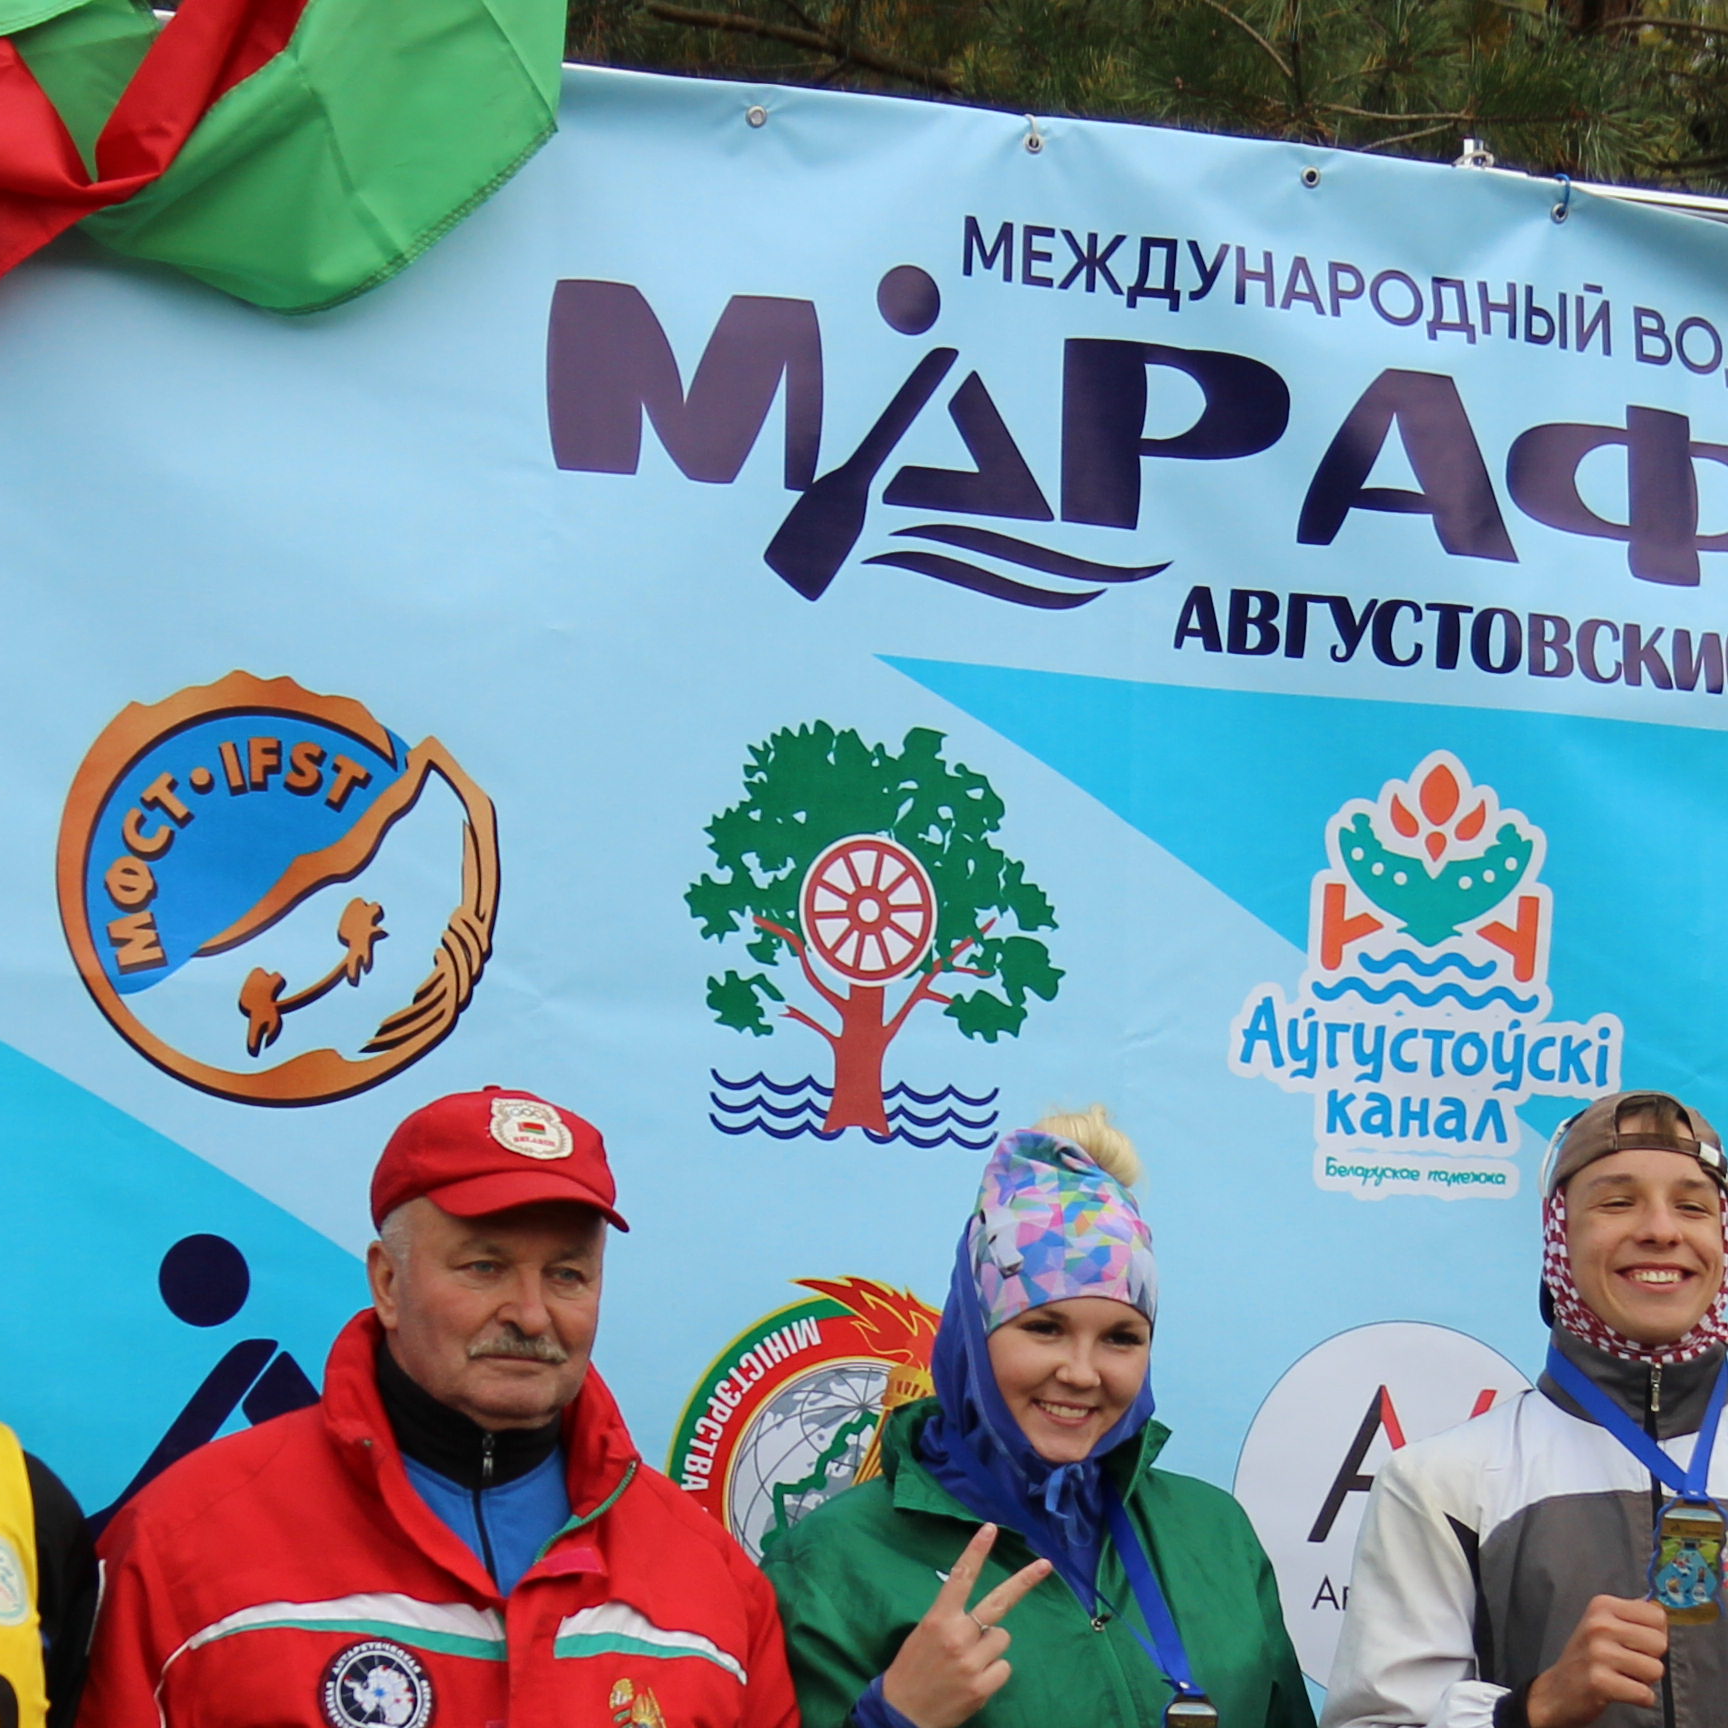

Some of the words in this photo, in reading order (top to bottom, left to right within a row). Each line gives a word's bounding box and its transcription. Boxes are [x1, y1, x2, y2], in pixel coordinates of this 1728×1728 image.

[960, 214, 1614, 357] МЕЖДУНАРОДНЫЙ
[219, 737, 372, 812] IFST
[1325, 1089, 1507, 1144] канал
[680, 1316, 822, 1492] МІНІСТЭРСТВА
